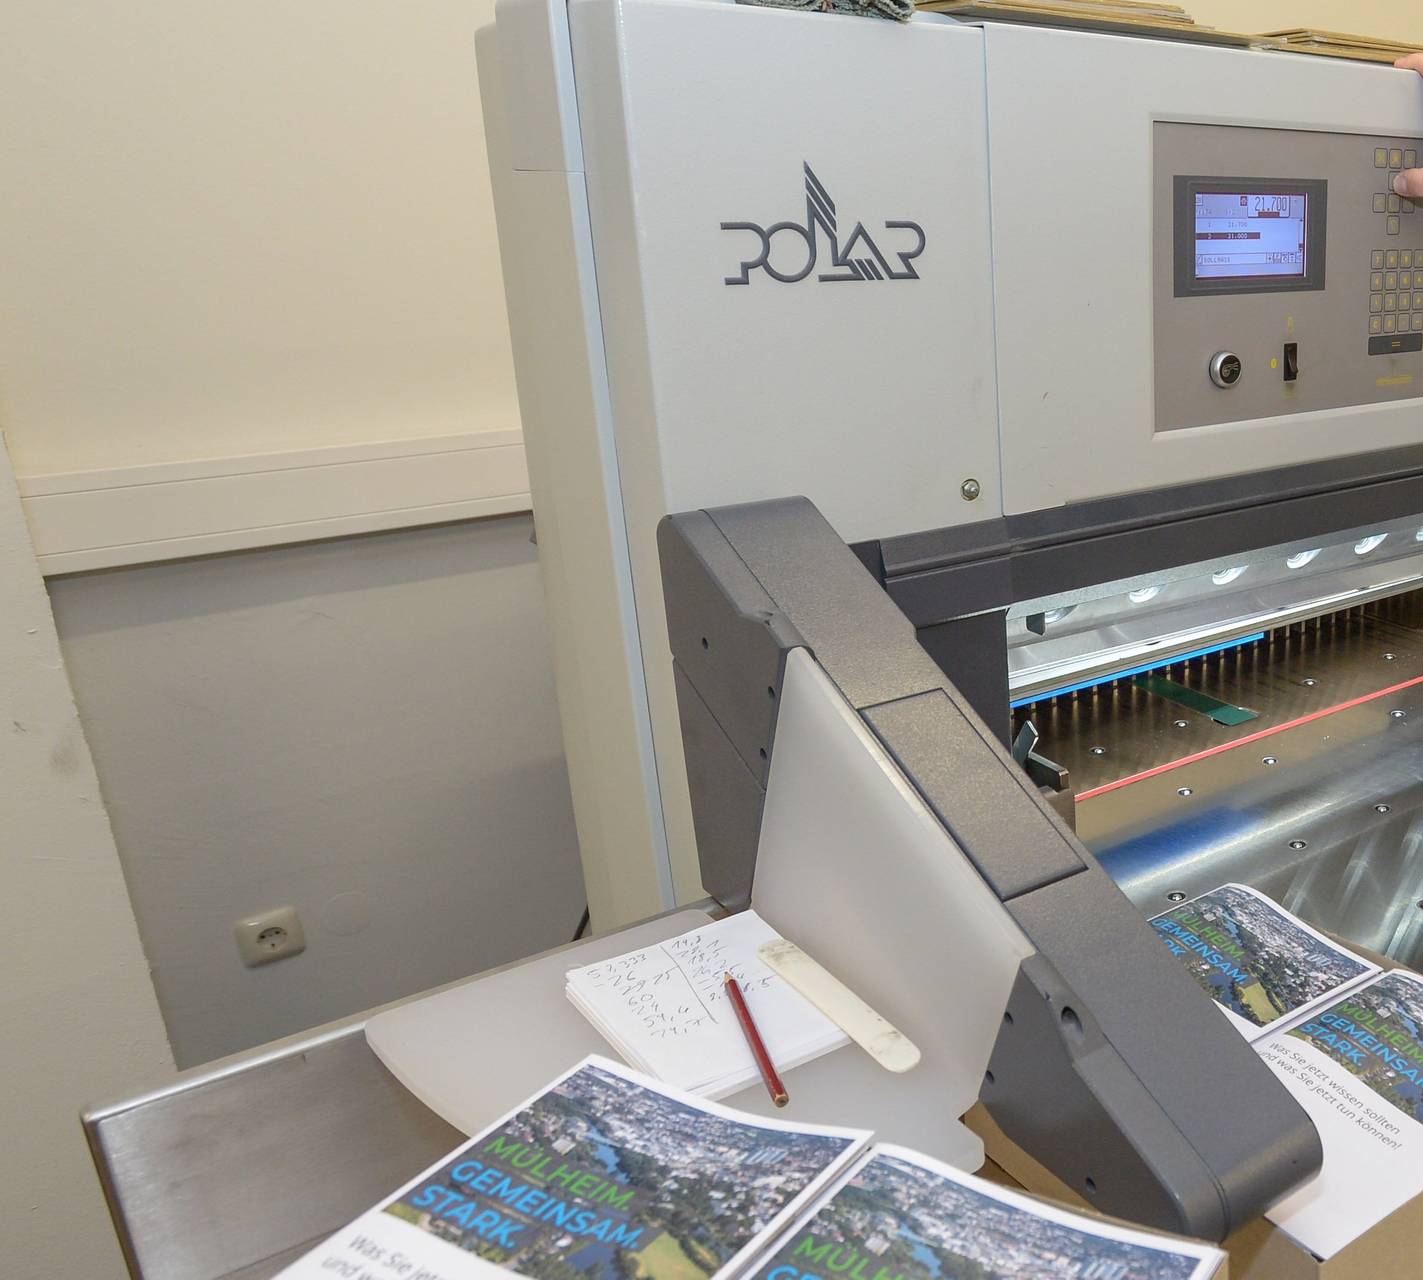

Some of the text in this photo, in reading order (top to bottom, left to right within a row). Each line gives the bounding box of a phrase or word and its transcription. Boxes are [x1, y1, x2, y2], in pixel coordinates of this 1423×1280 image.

[720, 160, 926, 286] POLAR
[1254, 196, 1287, 212] 21.700
[1301, 1023, 1367, 1067] STARK.
[1268, 1042, 1402, 1136] Was Sie jetzt wissen sollten
[1277, 1058, 1297, 1075] was
[1296, 1071, 1315, 1087] Sie
[1311, 1084, 1337, 1105] jetzt
[1336, 1102, 1357, 1120] tun
[1355, 1117, 1403, 1151] können!
[451, 1160, 646, 1249] GEMEINSAM.
[484, 1136, 637, 1212] MÜLHEIM.
[411, 1184, 527, 1249] STARK.
[348, 1234, 386, 1261] Was
[382, 1252, 413, 1276] Sie
